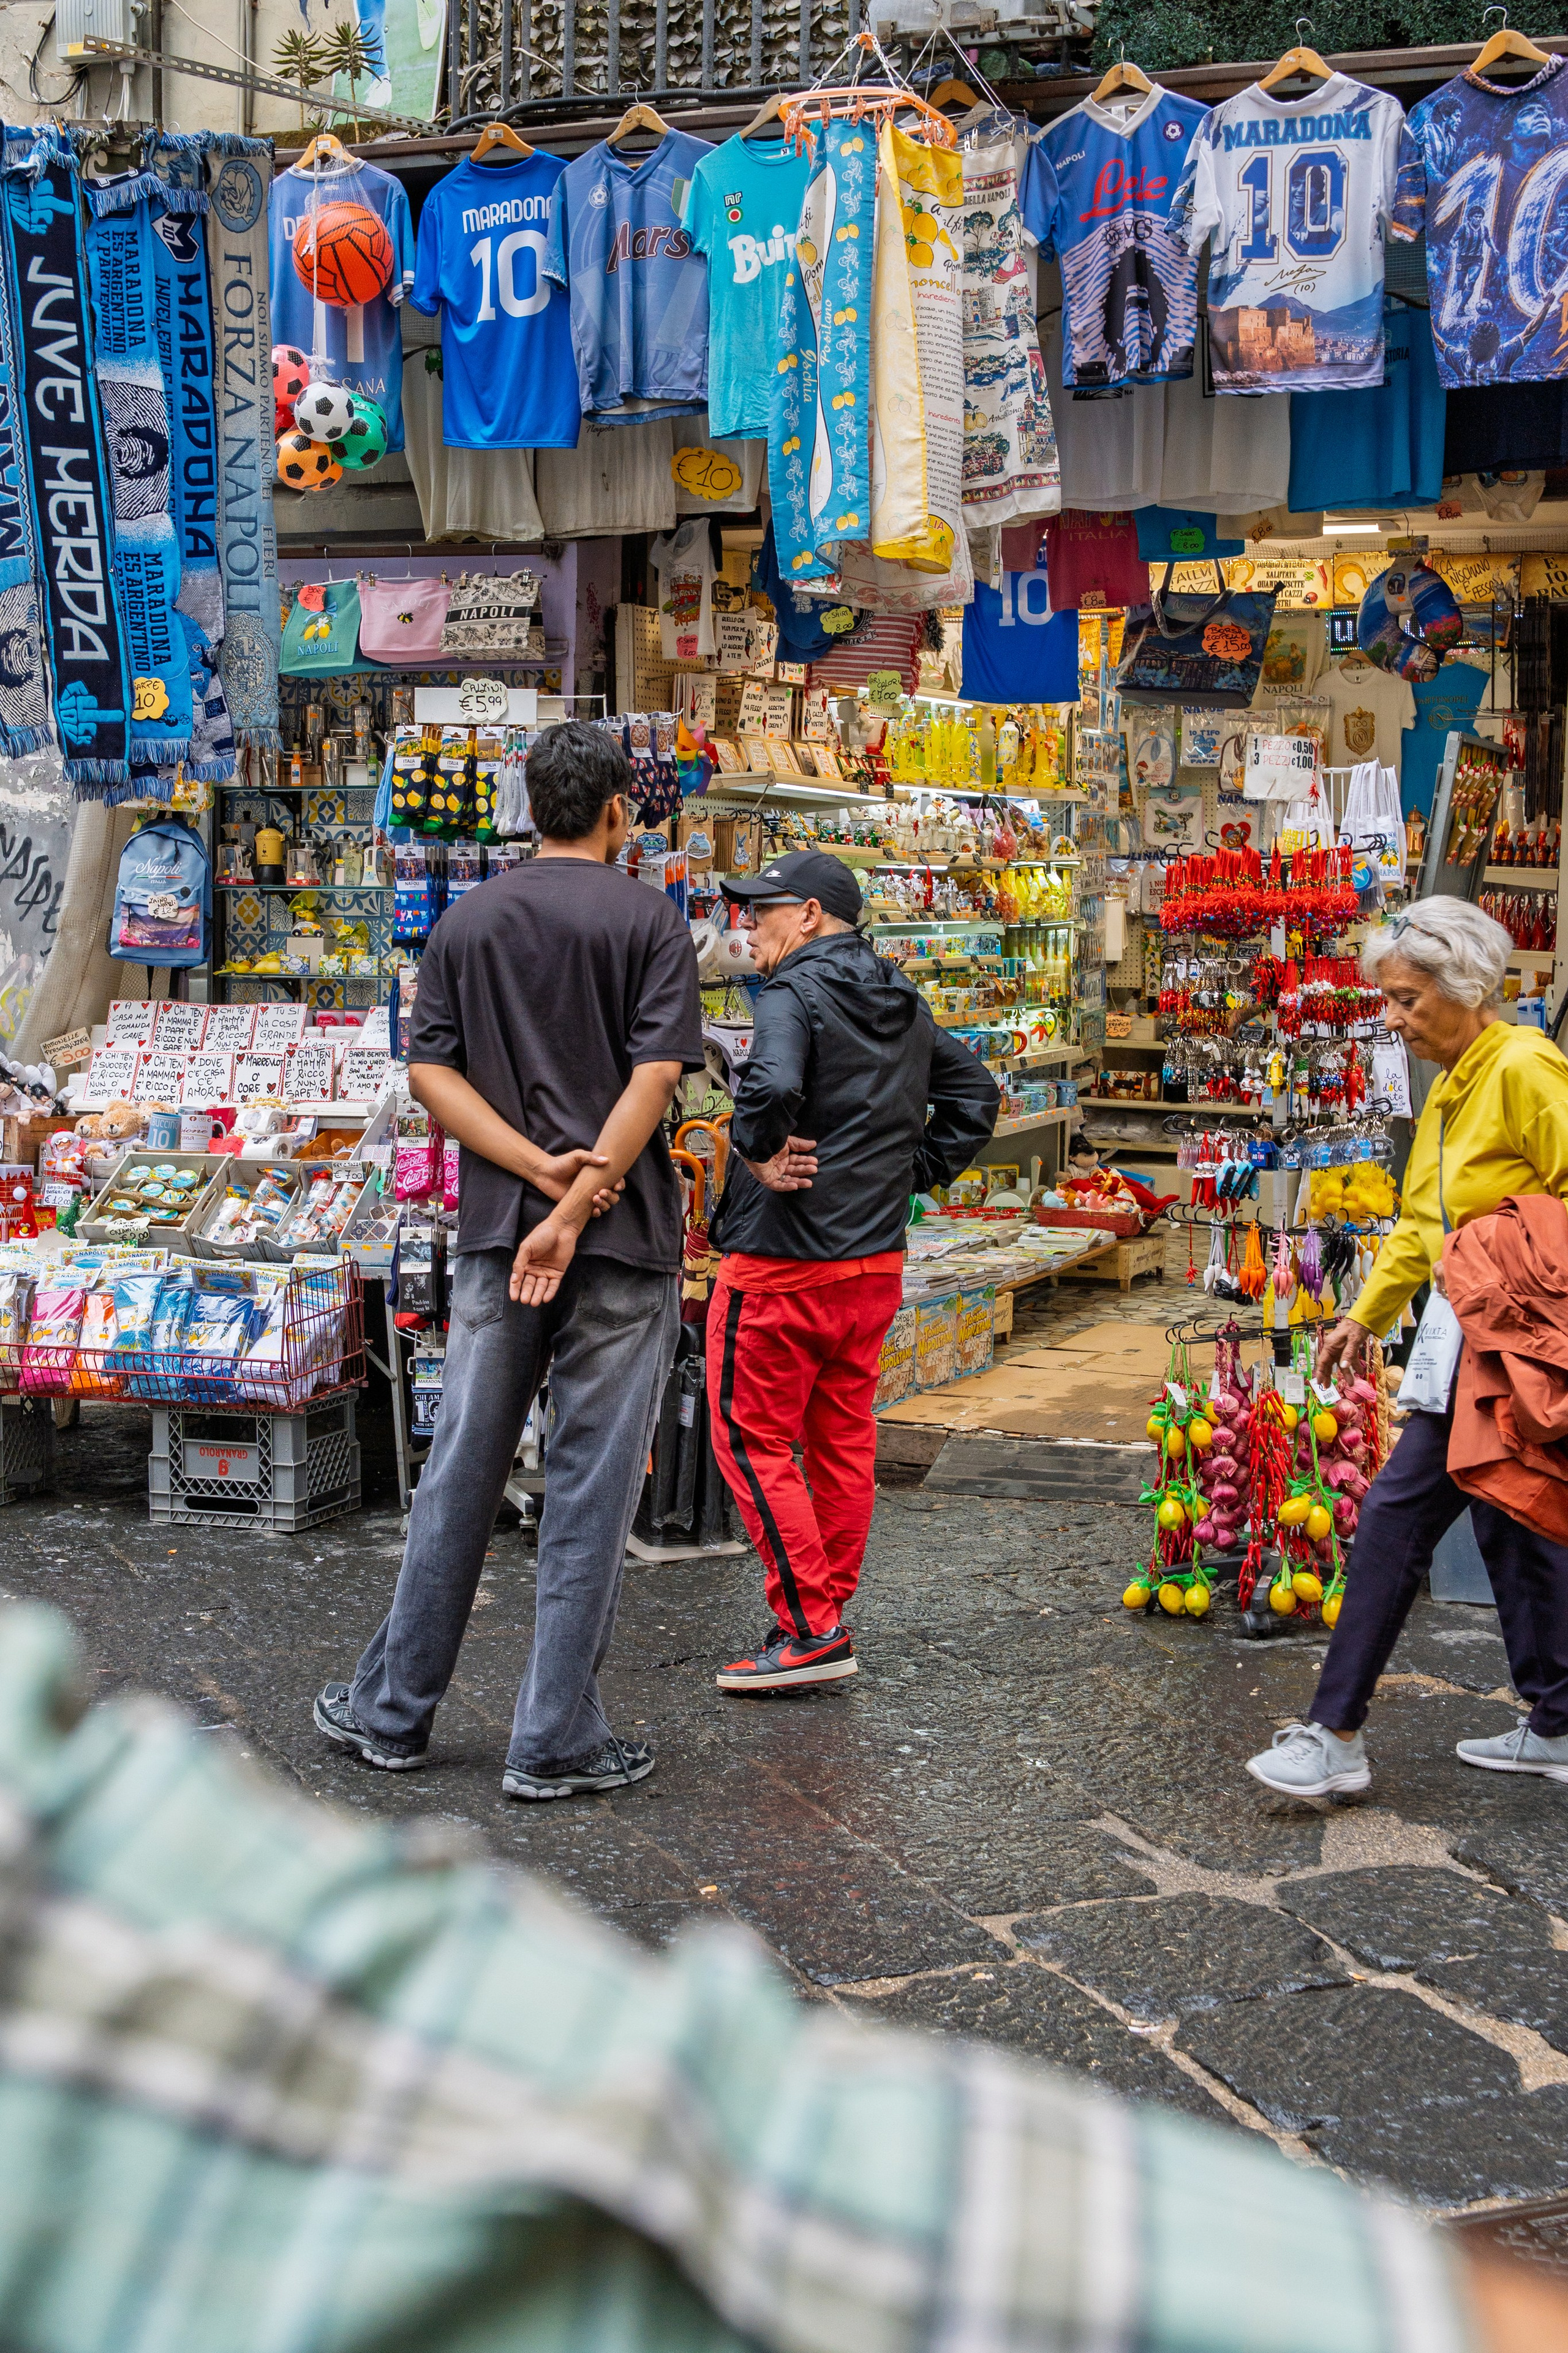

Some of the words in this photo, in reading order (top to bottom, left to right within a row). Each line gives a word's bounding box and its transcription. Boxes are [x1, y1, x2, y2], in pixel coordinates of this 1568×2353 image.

[1223, 111, 1372, 152] MARADONA
[1056, 151, 1085, 170] NAPOLI
[963, 195, 986, 206] BELLA
[987, 188, 1011, 203] NAPOLI
[1237, 145, 1349, 265] 10
[96, 232, 104, 246] Y
[112, 231, 123, 254] ES
[606, 221, 690, 274] Mars
[470, 229, 550, 323] 10
[125, 231, 148, 348] MARADONA
[97, 251, 113, 353] PARTENOPEI
[111, 260, 127, 354] ARGENTINO
[257, 292, 268, 327] NOI
[223, 250, 256, 422] FORZA
[820, 298, 832, 366] Positano
[28, 256, 86, 424] JUVE
[258, 332, 270, 389] SIAMO
[177, 273, 215, 558] MARADONA
[928, 410, 961, 425] Ingredients
[260, 395, 273, 502] PARTENOPEI
[224, 432, 260, 613] NAPOLI
[1069, 529, 1128, 541] ITALIA
[40, 446, 110, 660] MERDA
[262, 524, 275, 579] FIERI
[123, 553, 134, 573] ES
[1544, 557, 1558, 569] E
[1545, 570, 1567, 584] IO
[380, 598, 431, 613] NAPOLI
[999, 569, 1051, 627] 10
[143, 552, 172, 666] MARADONA
[460, 607, 515, 619] NAPOLI
[126, 578, 151, 672] ARGENTINO
[835, 622, 853, 632] 8.00
[297, 641, 339, 656] NAPOLI
[1262, 684, 1303, 694] NAPOLI
[1415, 695, 1469, 704] PARTENOPEI
[1254, 738, 1258, 750] 1
[1262, 740, 1291, 750] PEZZO
[1254, 753, 1259, 765] 3
[1262, 754, 1291, 766] PEZZI
[135, 858, 182, 877] Napoli
[190, 1008, 205, 1017] TEN
[218, 1016, 244, 1024] MAMMA
[167, 1017, 191, 1026] MAMMA
[258, 1018, 268, 1027] NA
[260, 1030, 296, 1041] GRANDE
[734, 1038, 739, 1048] I
[314, 1048, 331, 1058] TEN
[169, 1059, 183, 1068] TEN
[198, 1058, 223, 1067] DOVE
[297, 1059, 326, 1070] MAMMA
[147, 1070, 175, 1080] MAMMA
[203, 1068, 225, 1077] CASA
[1384, 1068, 1401, 1079] la
[187, 1086, 222, 1100] AMORE
[238, 1083, 260, 1093] CORE
[153, 1128, 170, 1149] 10
[410, 1181, 426, 1193] ITALIA
[965, 1310, 987, 1327] TOMBOLA
[924, 1323, 948, 1339] TOMBOLA
[959, 1317, 992, 1343] NAPOLETANA
[1425, 1327, 1447, 1336] VIXTA
[903, 1333, 911, 1347] 10
[918, 1331, 953, 1359] NAPOLETANA
[199, 1446, 248, 1459] GRANAROLO
